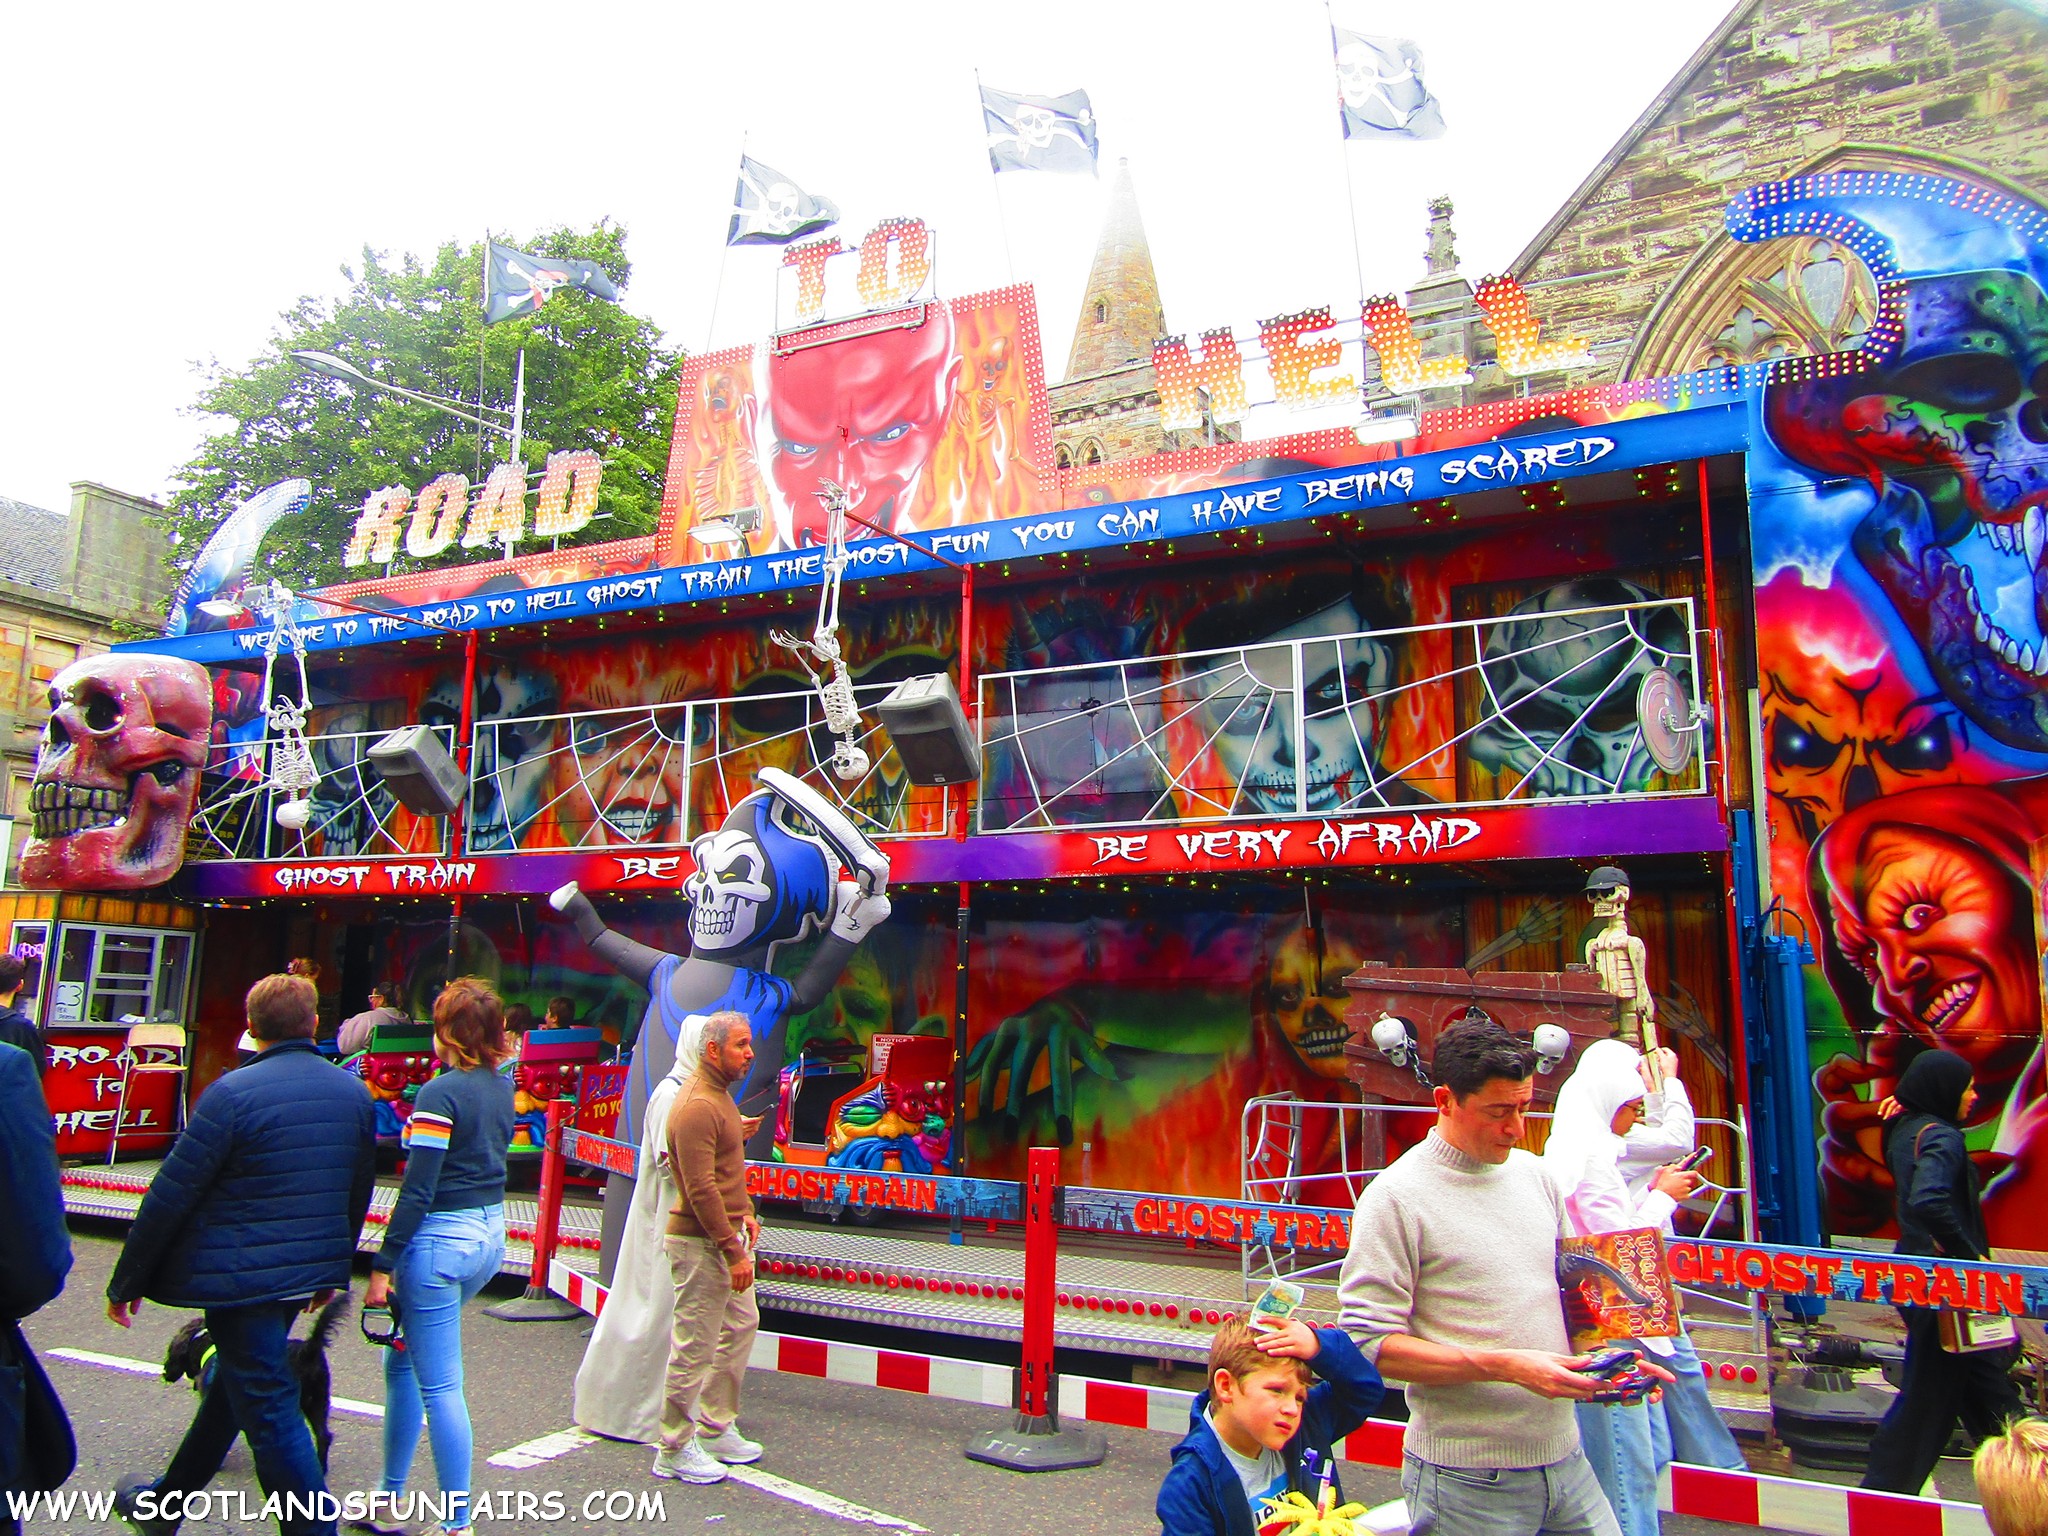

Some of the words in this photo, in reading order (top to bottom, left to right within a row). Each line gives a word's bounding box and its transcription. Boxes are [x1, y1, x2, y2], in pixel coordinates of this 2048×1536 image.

[344, 448, 602, 567] ROAD
[783, 215, 931, 327] TO
[1151, 271, 1597, 431] HELL
[238, 625, 327, 652] WECME
[332, 619, 358, 642] TO
[368, 612, 409, 637] THE
[420, 601, 480, 630] ROAD
[487, 598, 516, 621] TO
[526, 589, 577, 615] HELL
[586, 576, 662, 609] GHOST
[681, 563, 752, 595] TRAIN
[768, 554, 821, 584] THE
[930, 530, 990, 560] FUN
[1011, 520, 1076, 550] YOU
[1097, 507, 1159, 539] CAN
[1190, 486, 1284, 526] HAVE
[1297, 467, 1415, 508] BEING
[1440, 435, 1615, 484] SCARED
[1087, 834, 1148, 866] BE
[1176, 829, 1292, 863] VERY
[1308, 812, 1482, 862] AFRAID
[275, 865, 370, 894] GHOST
[384, 860, 477, 890] TRAIN
[613, 856, 682, 883] BE
[46, 1041, 177, 1072] ROAD
[586, 1073, 627, 1101] PLEA
[54, 1108, 158, 1135] HELL
[593, 1102, 608, 1119] TO
[745, 1165, 840, 1201] GHOST
[845, 1173, 938, 1211] TRAIN
[1133, 1197, 1262, 1241] GHOST
[1267, 1208, 1354, 1250] TRA
[1667, 1242, 1842, 1295] GHOST
[1852, 1258, 2025, 1316] TRAIN
